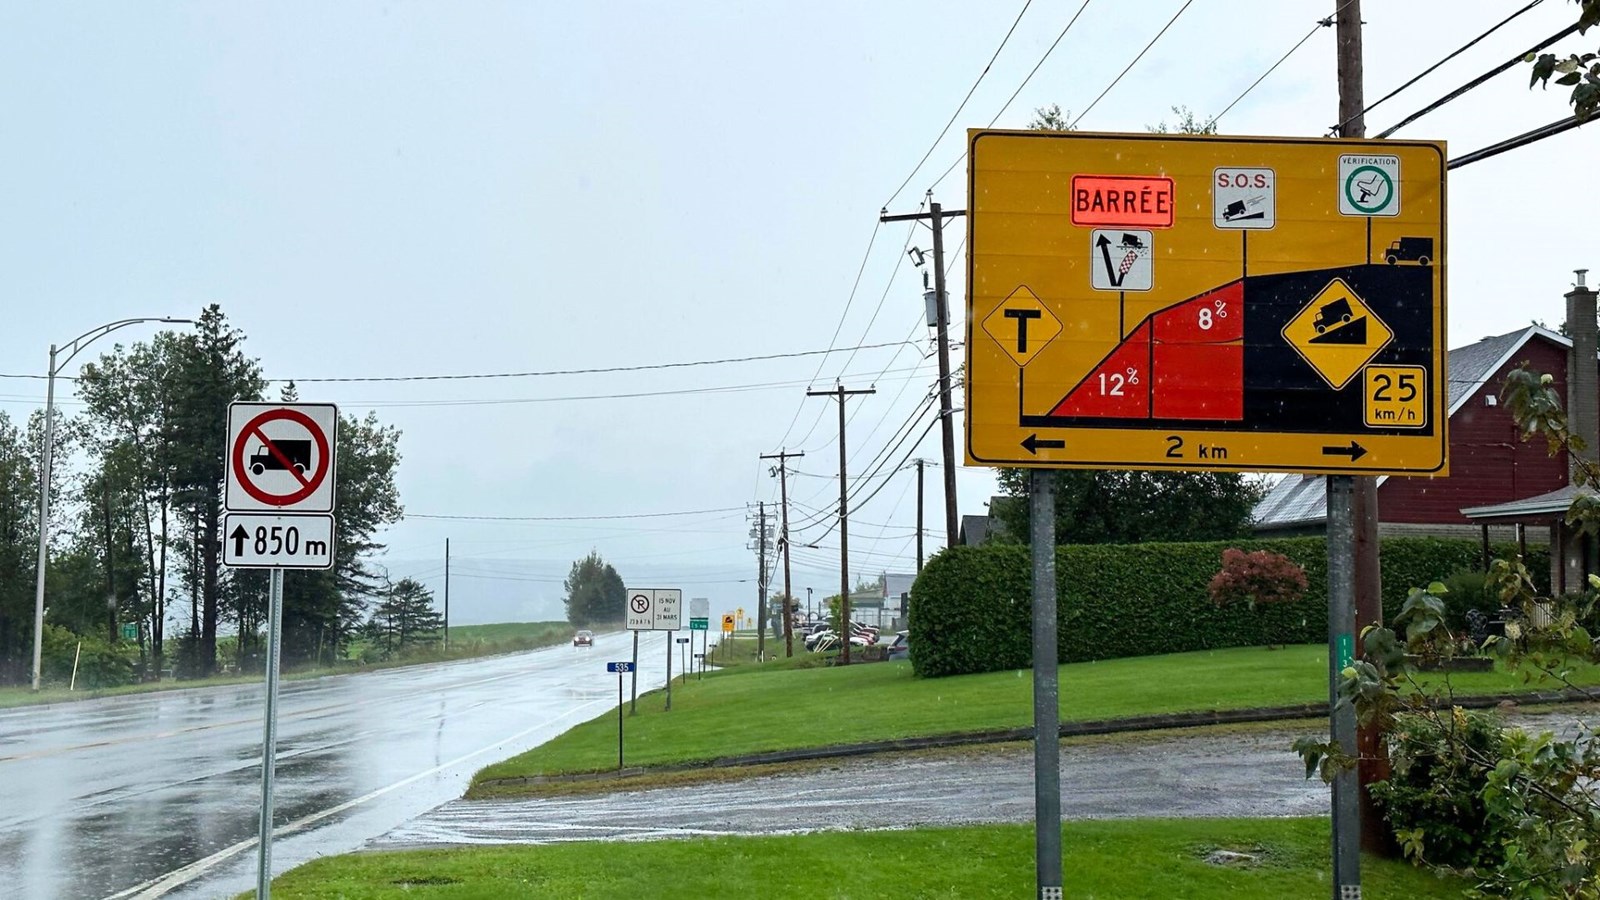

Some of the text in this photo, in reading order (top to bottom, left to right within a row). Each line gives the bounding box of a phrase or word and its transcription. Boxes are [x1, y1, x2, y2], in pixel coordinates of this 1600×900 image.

[1343, 156, 1397, 166] VÉRIFICATION
[1218, 173, 1270, 189] S.O.S.
[1077, 186, 1168, 214] BARRÉE
[1198, 299, 1227, 330] 8%
[1098, 367, 1139, 396] 12%
[1373, 374, 1416, 402] 25
[1166, 436, 1228, 459] 2 km
[254, 526, 326, 555] 850 m
[615, 662, 629, 671] 535
